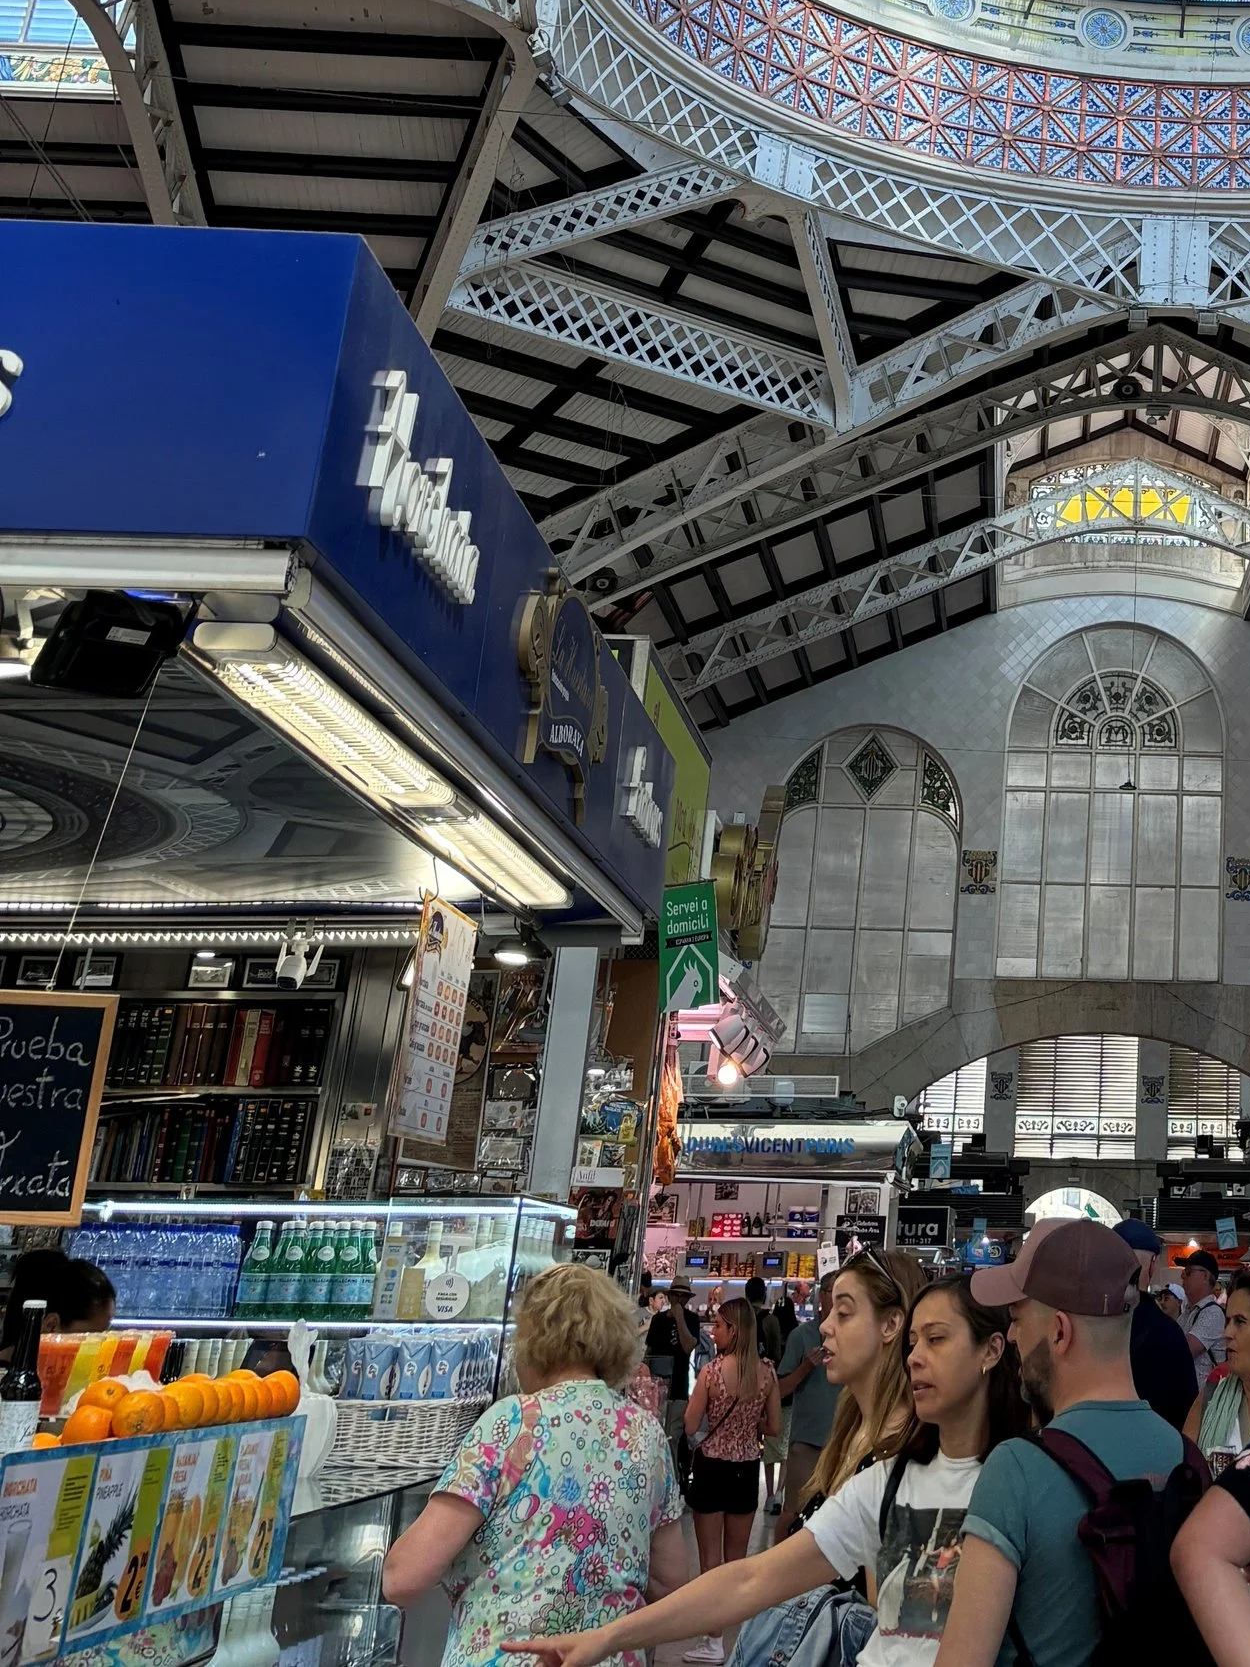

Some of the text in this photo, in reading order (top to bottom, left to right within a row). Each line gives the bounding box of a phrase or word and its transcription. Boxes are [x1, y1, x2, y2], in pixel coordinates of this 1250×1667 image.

[549, 724, 584, 758] ALBORAYA
[666, 896, 708, 917] Servei a
[667, 913, 709, 935] domicili
[898, 1221, 939, 1236] tura
[437, 1305, 453, 1313] VISA
[33, 1567, 58, 1622] 3
